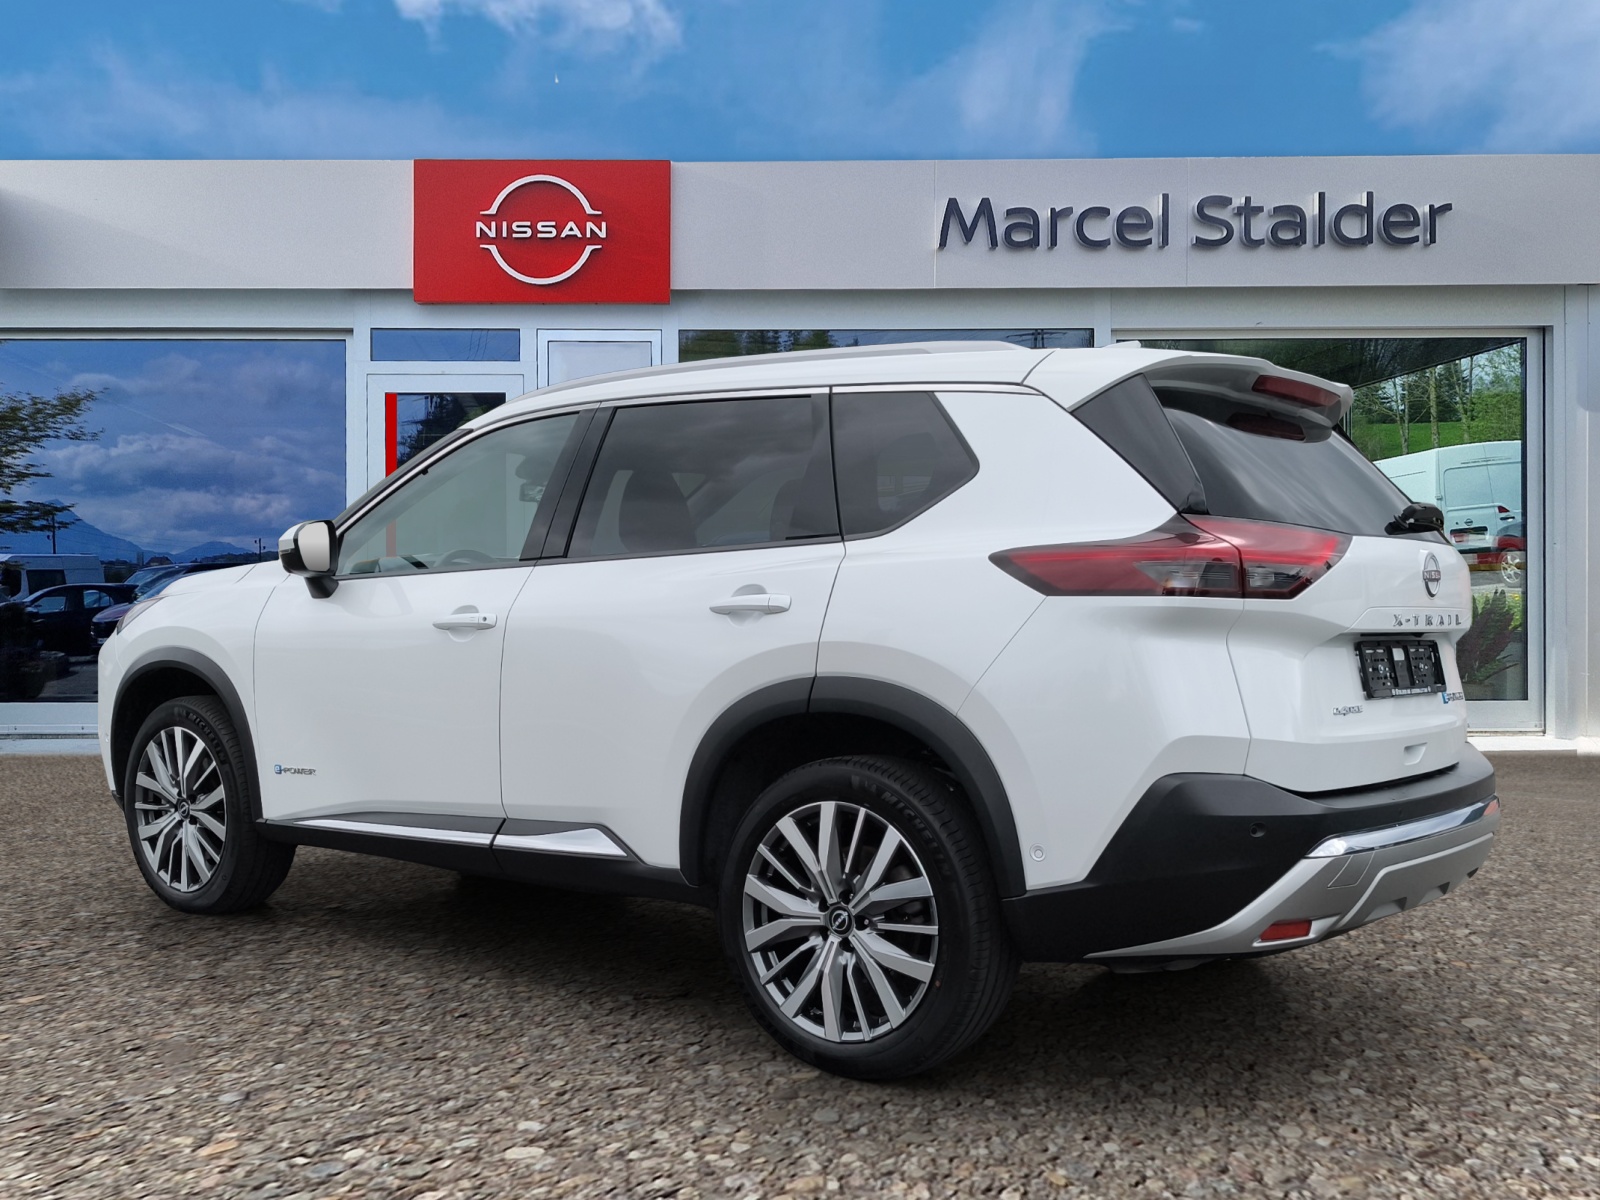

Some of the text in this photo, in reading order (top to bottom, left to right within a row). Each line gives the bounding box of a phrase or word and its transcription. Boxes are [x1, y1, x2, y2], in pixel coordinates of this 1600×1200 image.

[475, 221, 607, 238] NISSAN
[938, 190, 1453, 249] Marcel Stalder
[1393, 613, 1462, 628] X-TRAIL
[880, 790, 953, 877] MICHELIN
